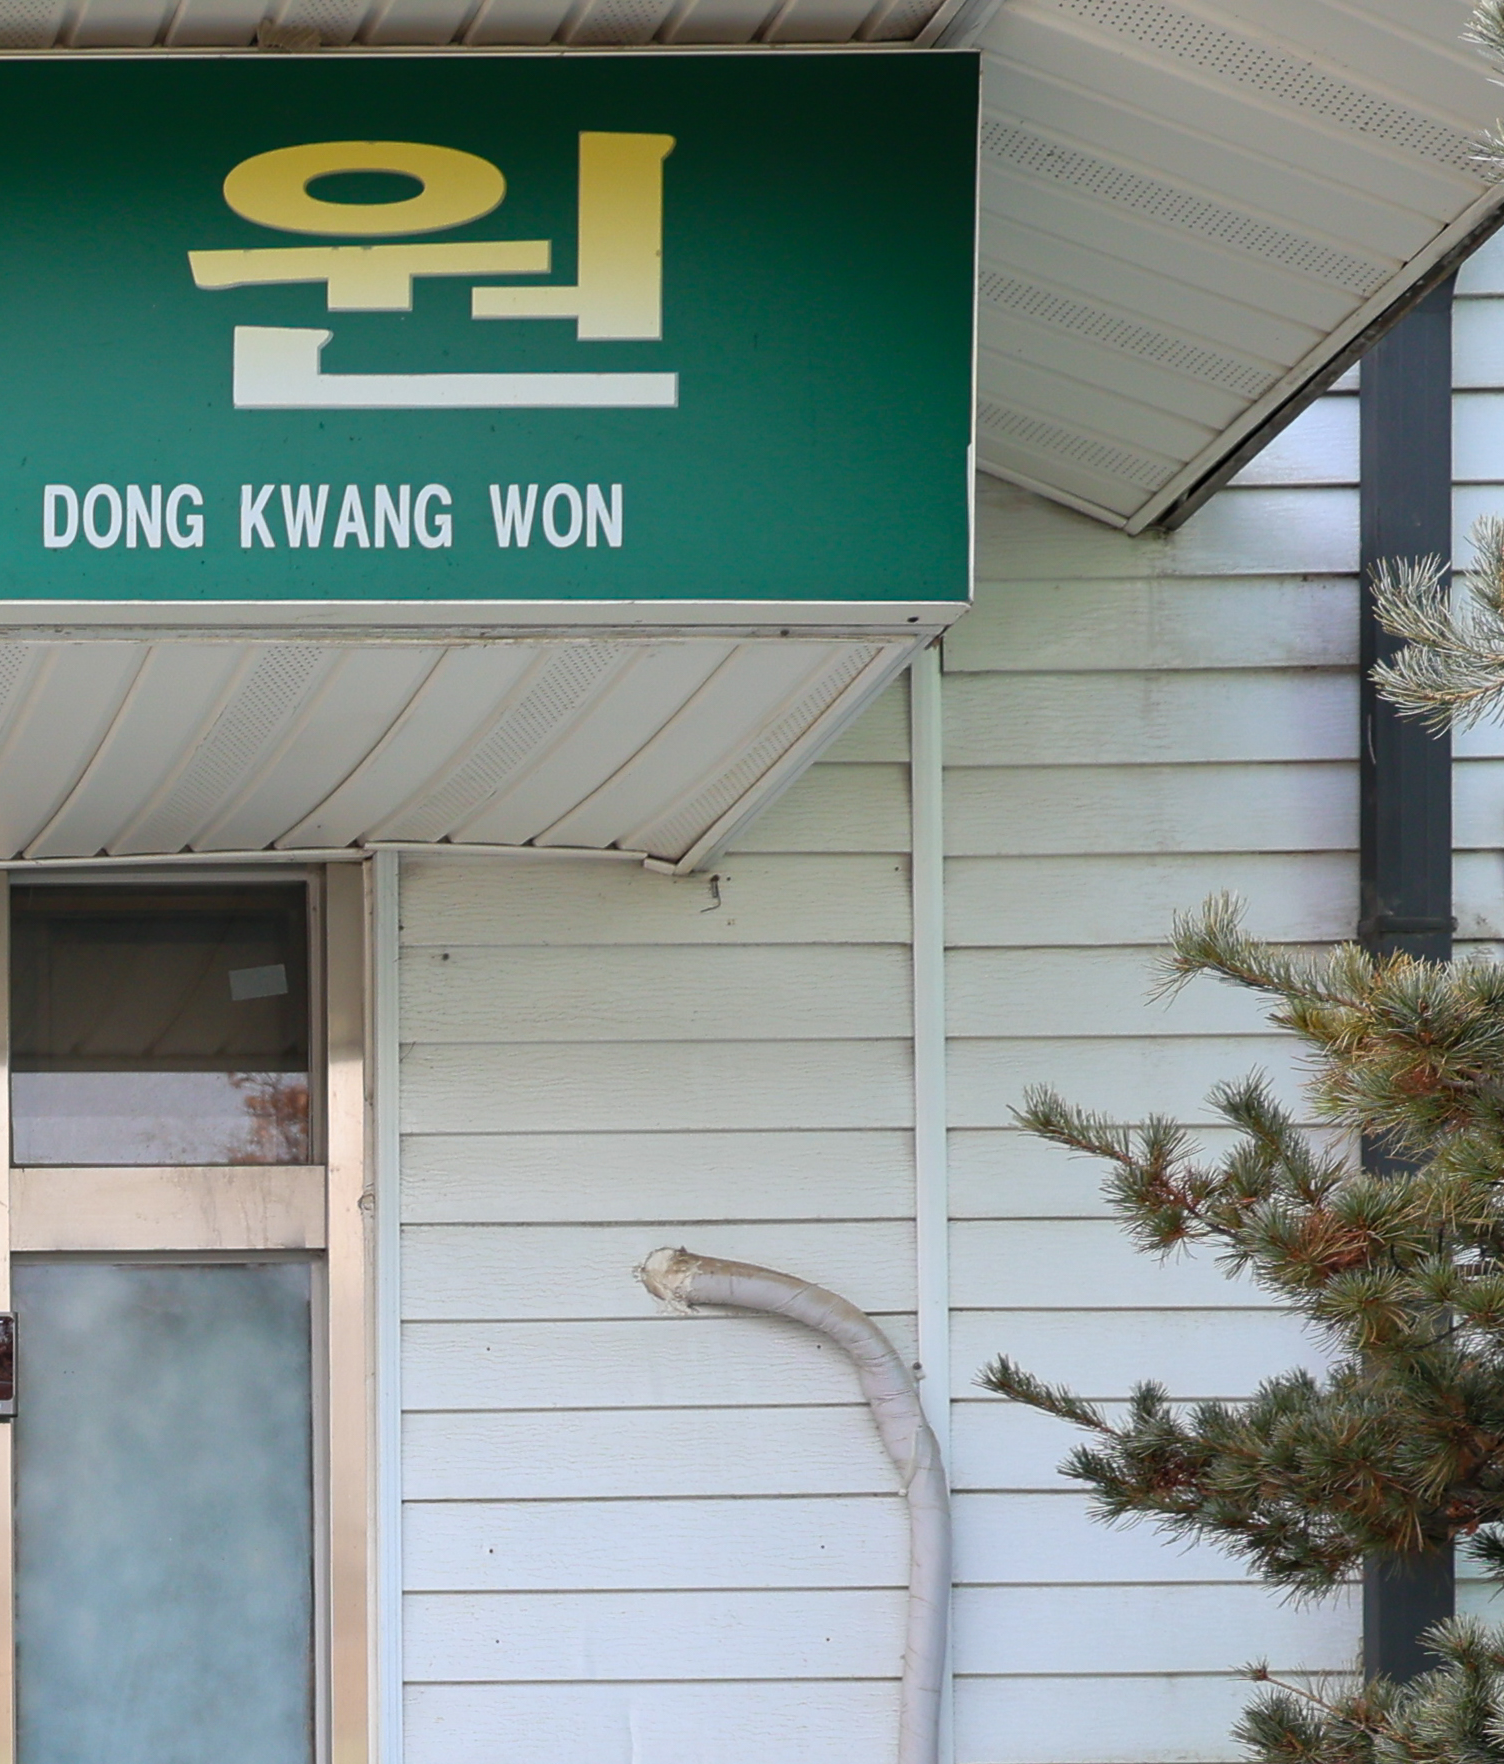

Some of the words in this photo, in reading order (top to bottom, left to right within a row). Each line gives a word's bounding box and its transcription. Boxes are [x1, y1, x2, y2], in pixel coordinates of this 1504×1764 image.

[43, 484, 204, 549] DONG
[240, 484, 452, 549] KWANG
[489, 483, 622, 548] WON
